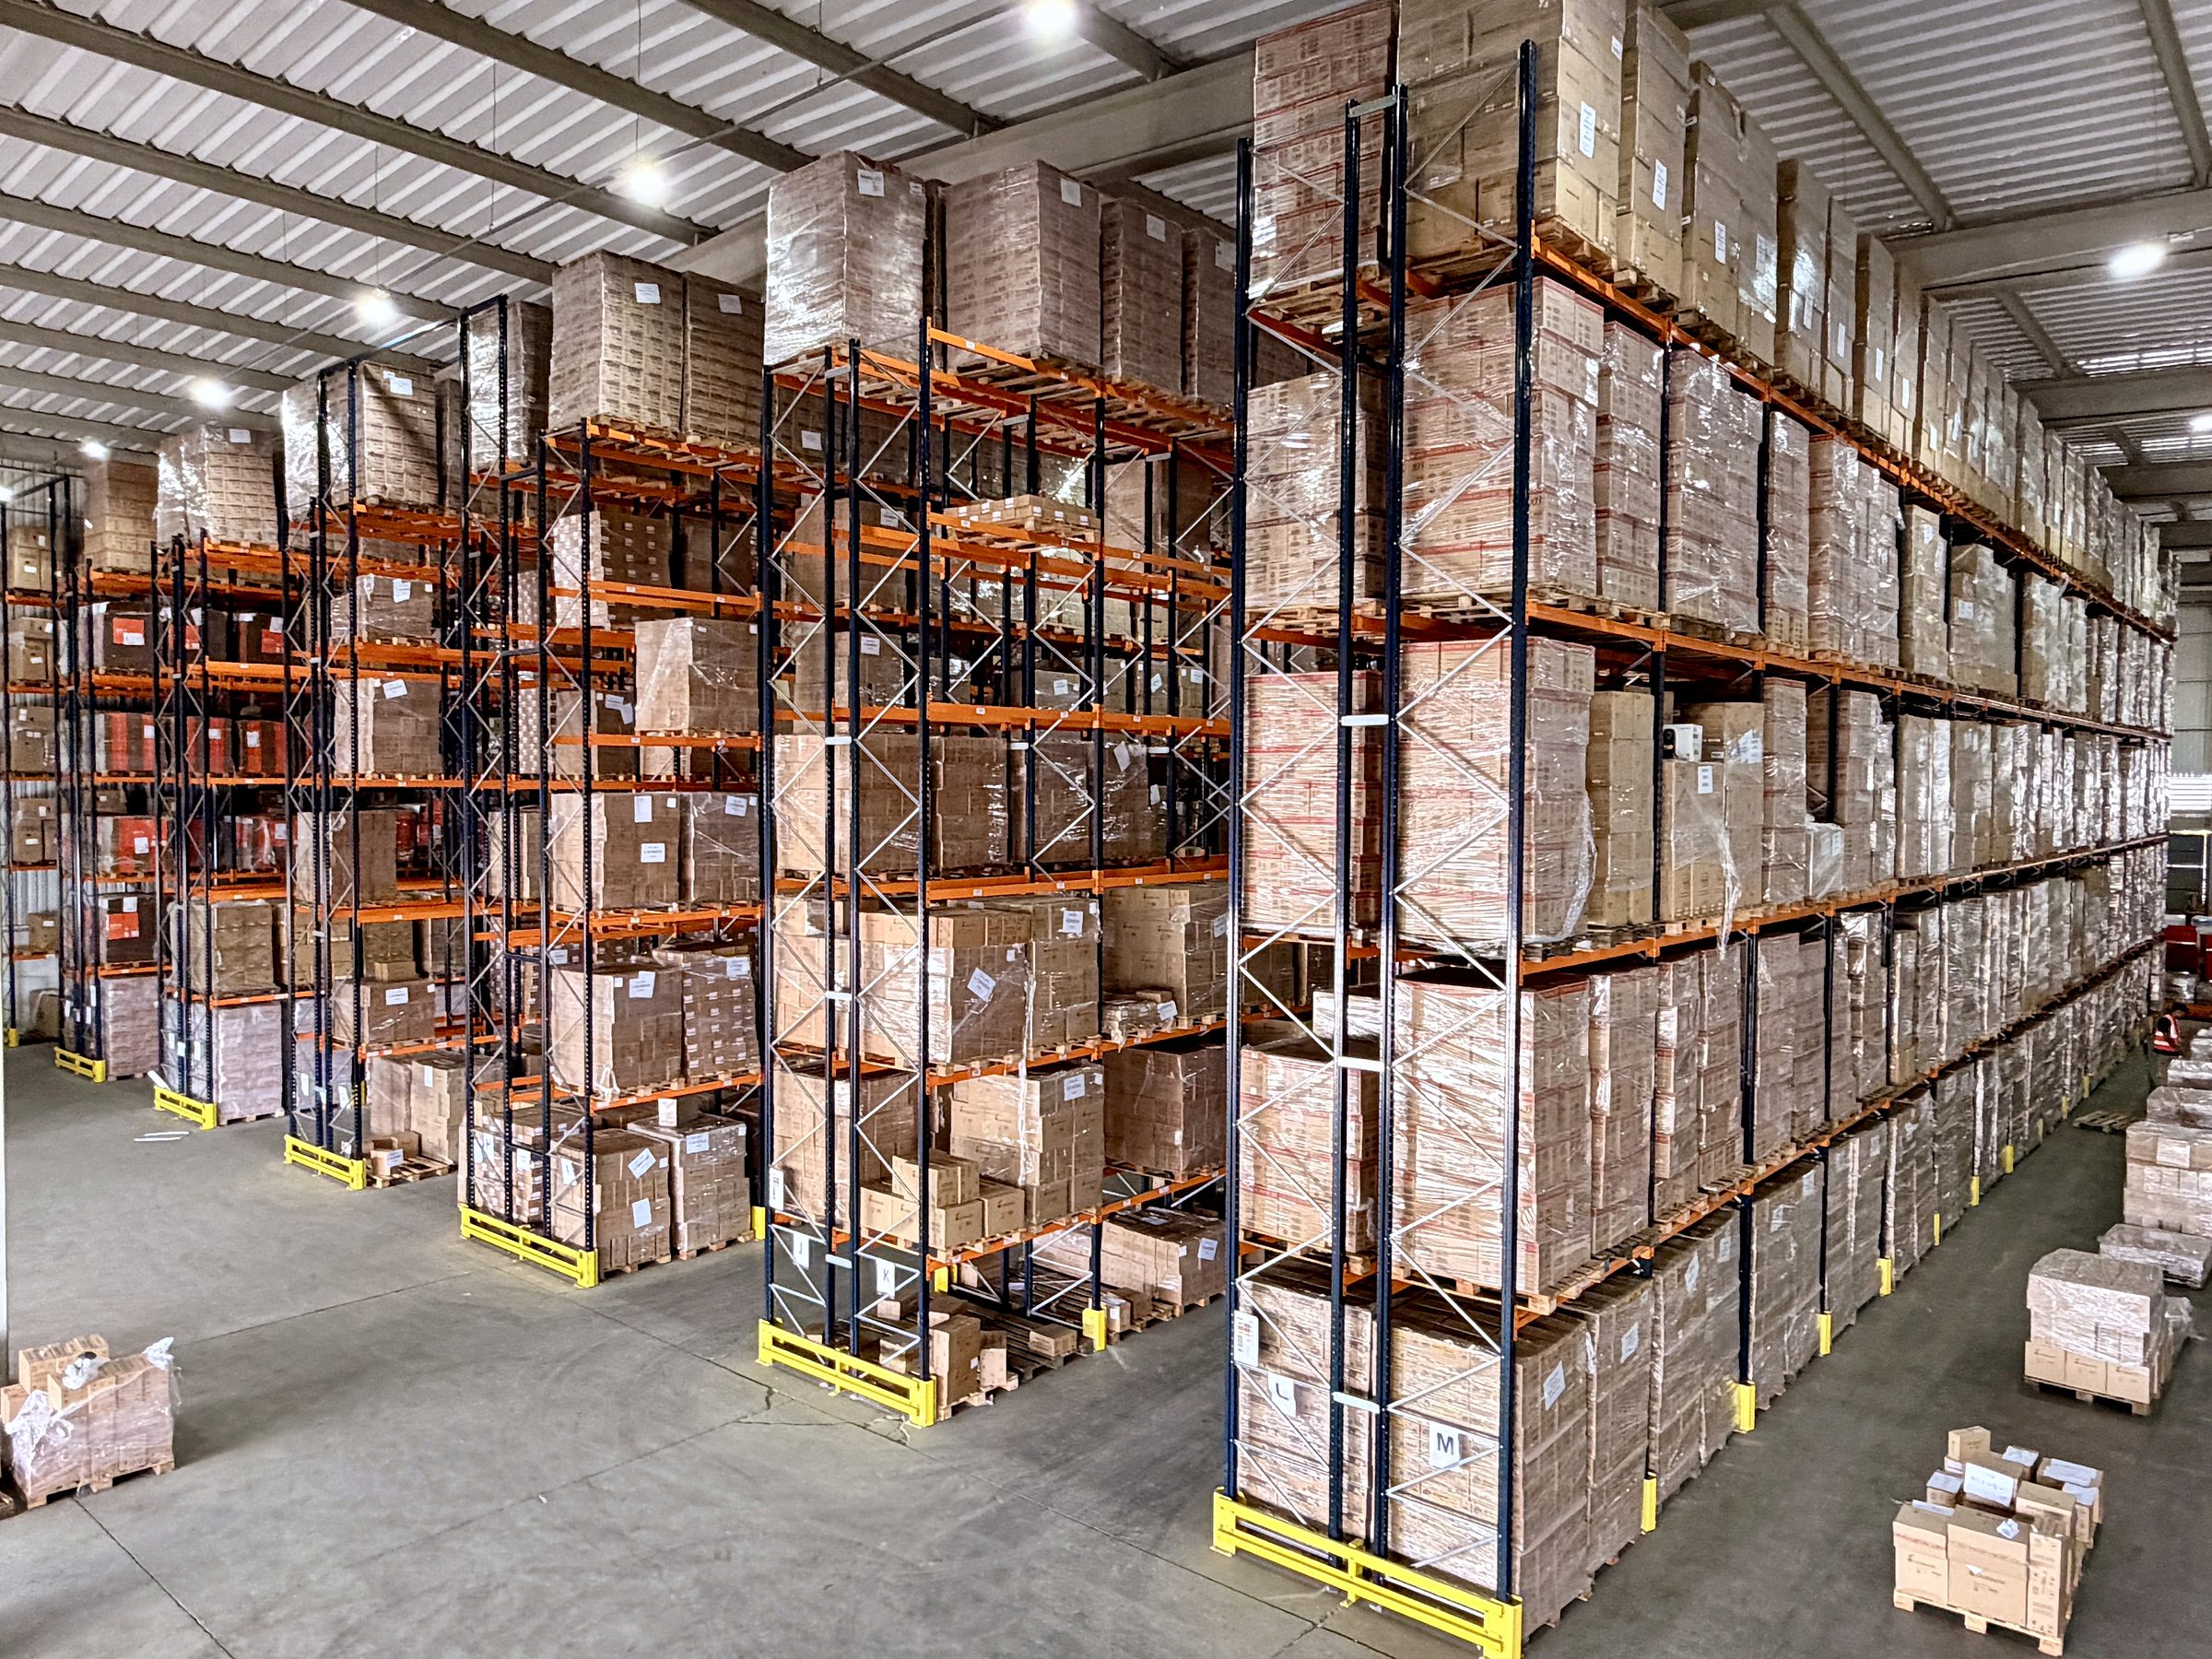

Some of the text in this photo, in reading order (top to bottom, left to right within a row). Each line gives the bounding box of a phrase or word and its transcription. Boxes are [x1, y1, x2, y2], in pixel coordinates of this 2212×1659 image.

[883, 1268, 890, 1282] K
[1276, 1382, 1288, 1400] L
[1437, 1432, 1453, 1454] M
